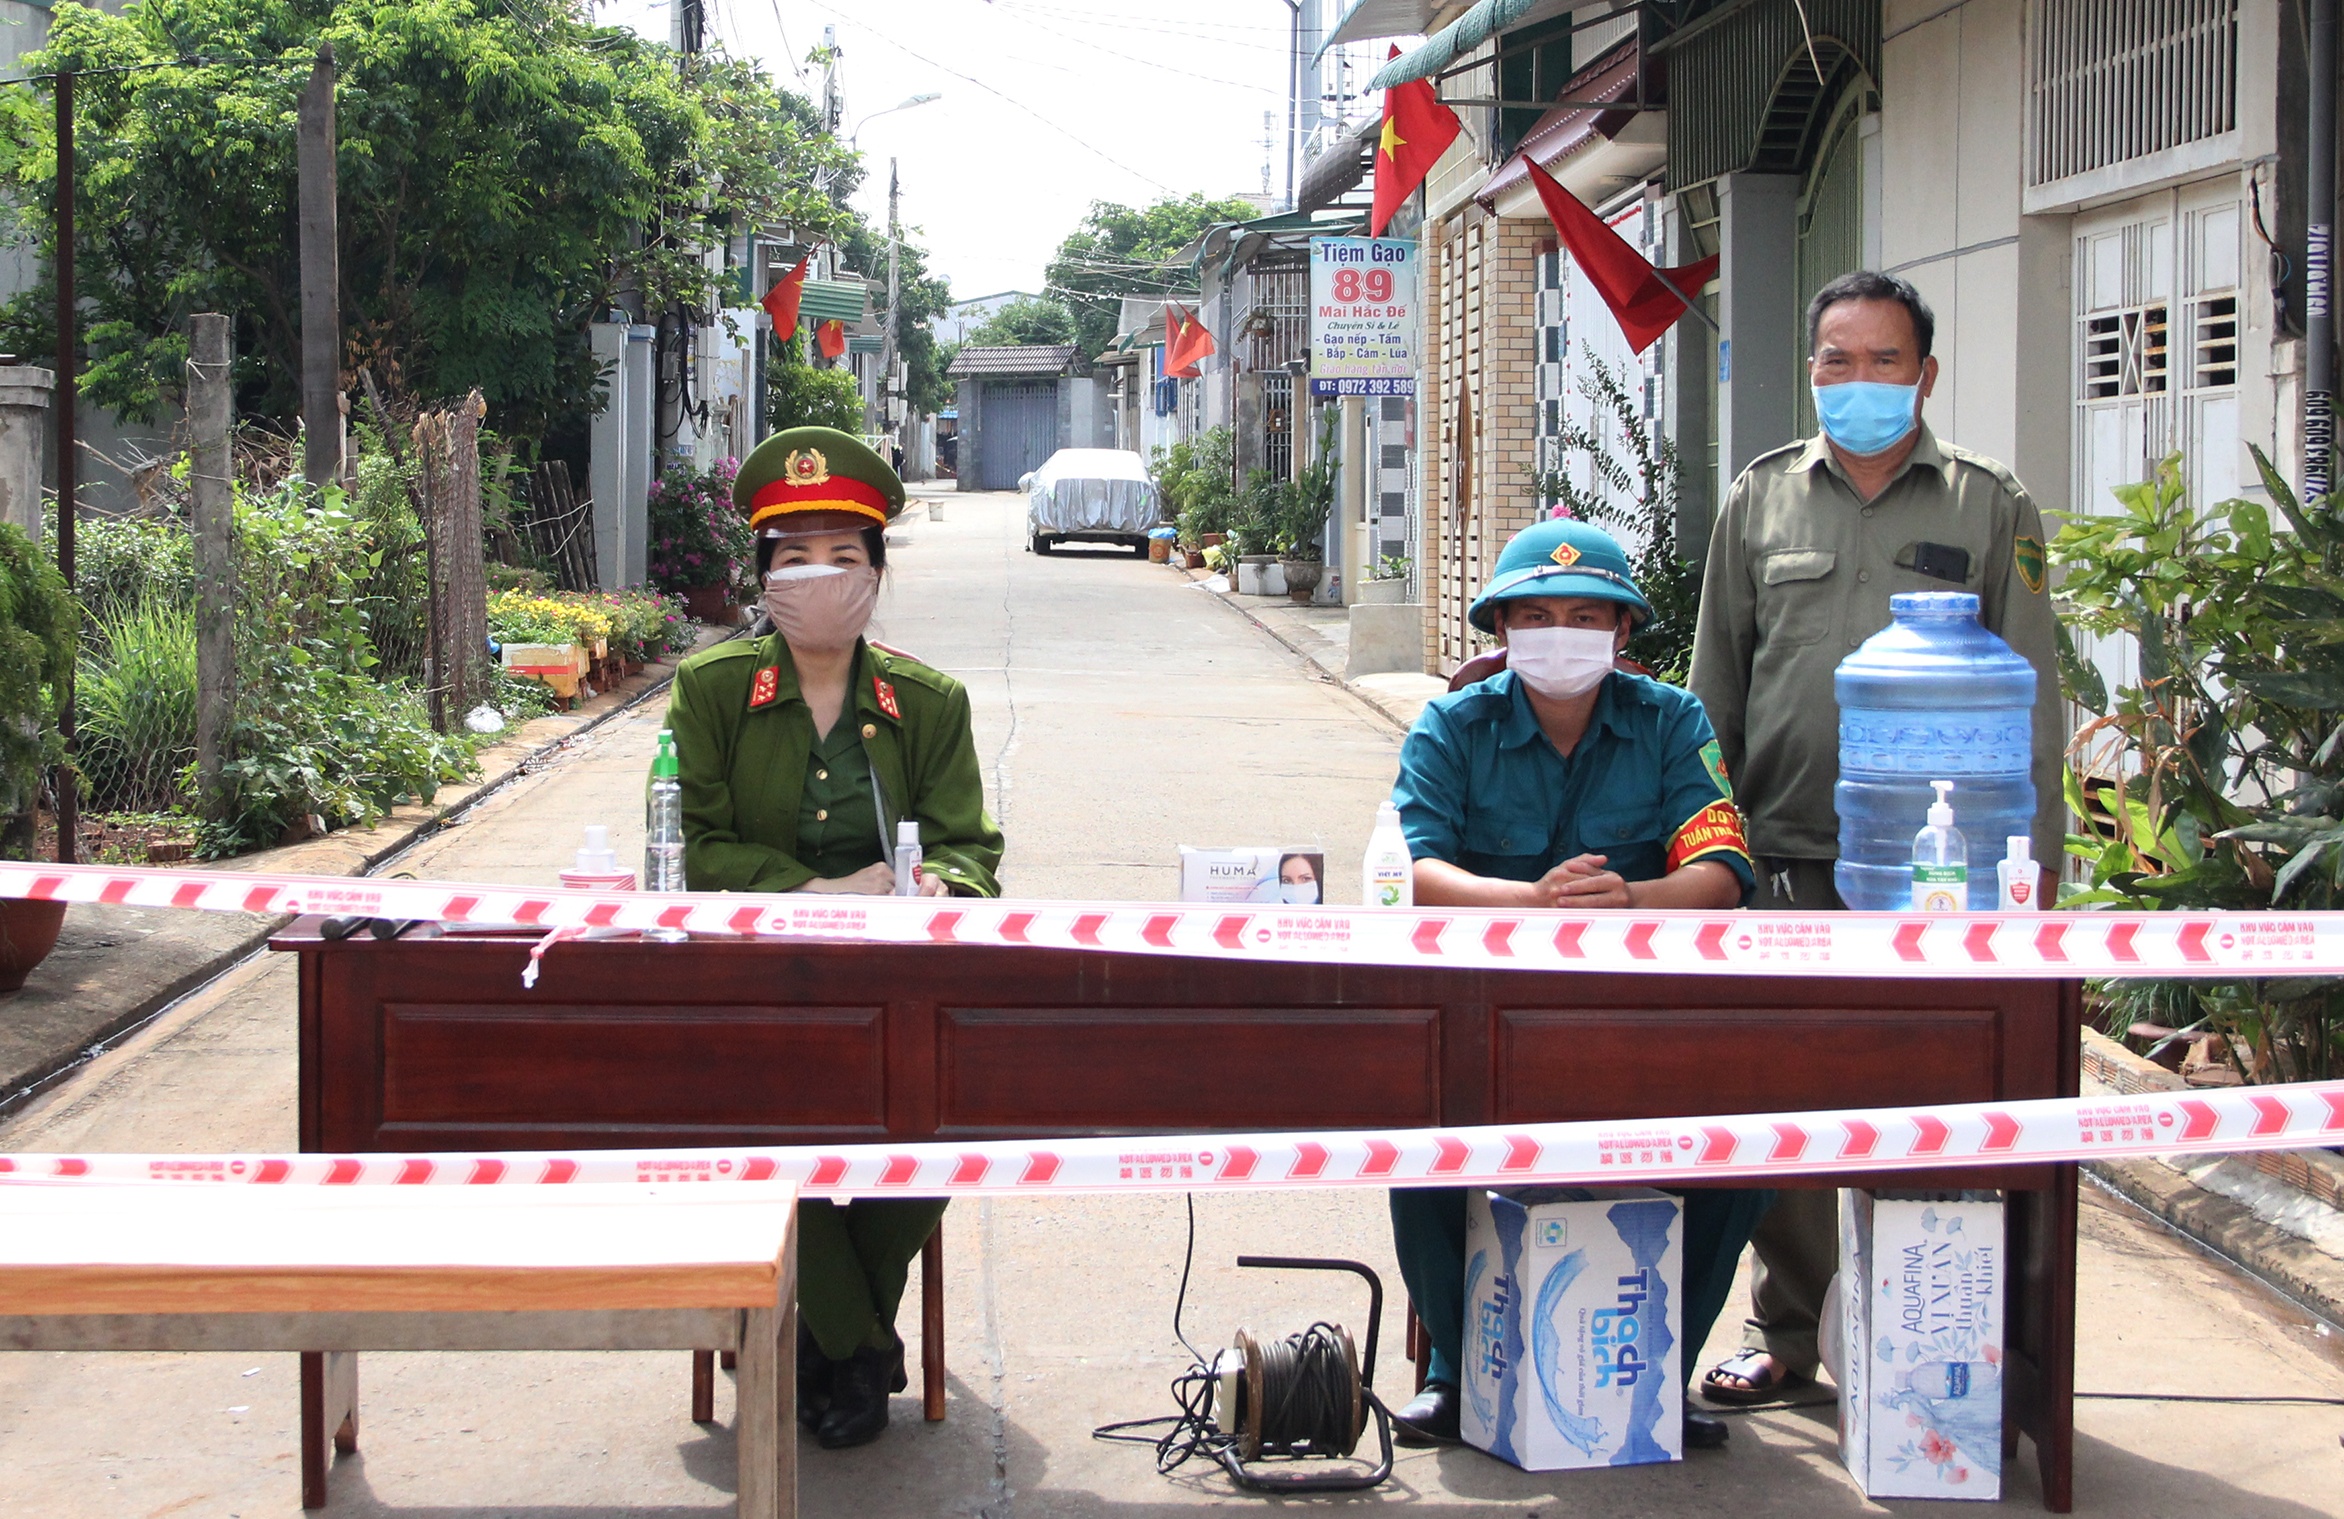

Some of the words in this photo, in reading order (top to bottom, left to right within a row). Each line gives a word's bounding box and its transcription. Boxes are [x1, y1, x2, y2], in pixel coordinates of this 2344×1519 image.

[1321, 243, 1364, 267] Tiệm
[1371, 243, 1405, 267] Gạo
[1332, 267, 1395, 304] 89
[1318, 306, 1346, 318] Mai
[1352, 304, 1381, 318] Hắc
[1386, 304, 1407, 318] Đế
[1327, 321, 1363, 332] Chuyên
[1377, 322, 1385, 330] &
[1324, 334, 1344, 347] Gạo
[1347, 332, 1367, 346] nếp
[1378, 332, 1401, 344] Tấm
[1327, 347, 1346, 360] Bắp
[1356, 348, 1379, 359] Cám
[1390, 347, 1407, 359] Lúa
[1319, 381, 1336, 391] ĐT:
[1338, 379, 1366, 394] 0972
[1369, 379, 1391, 394] 392
[1393, 379, 1414, 394] 589
[1210, 866, 1256, 876] HUMA
[1925, 1242, 1951, 1305] XUÂN
[1974, 1246, 1993, 1295] khiết
[1901, 1242, 1925, 1334] AQUAFINA
[1930, 1313, 1955, 1334] VỊ
